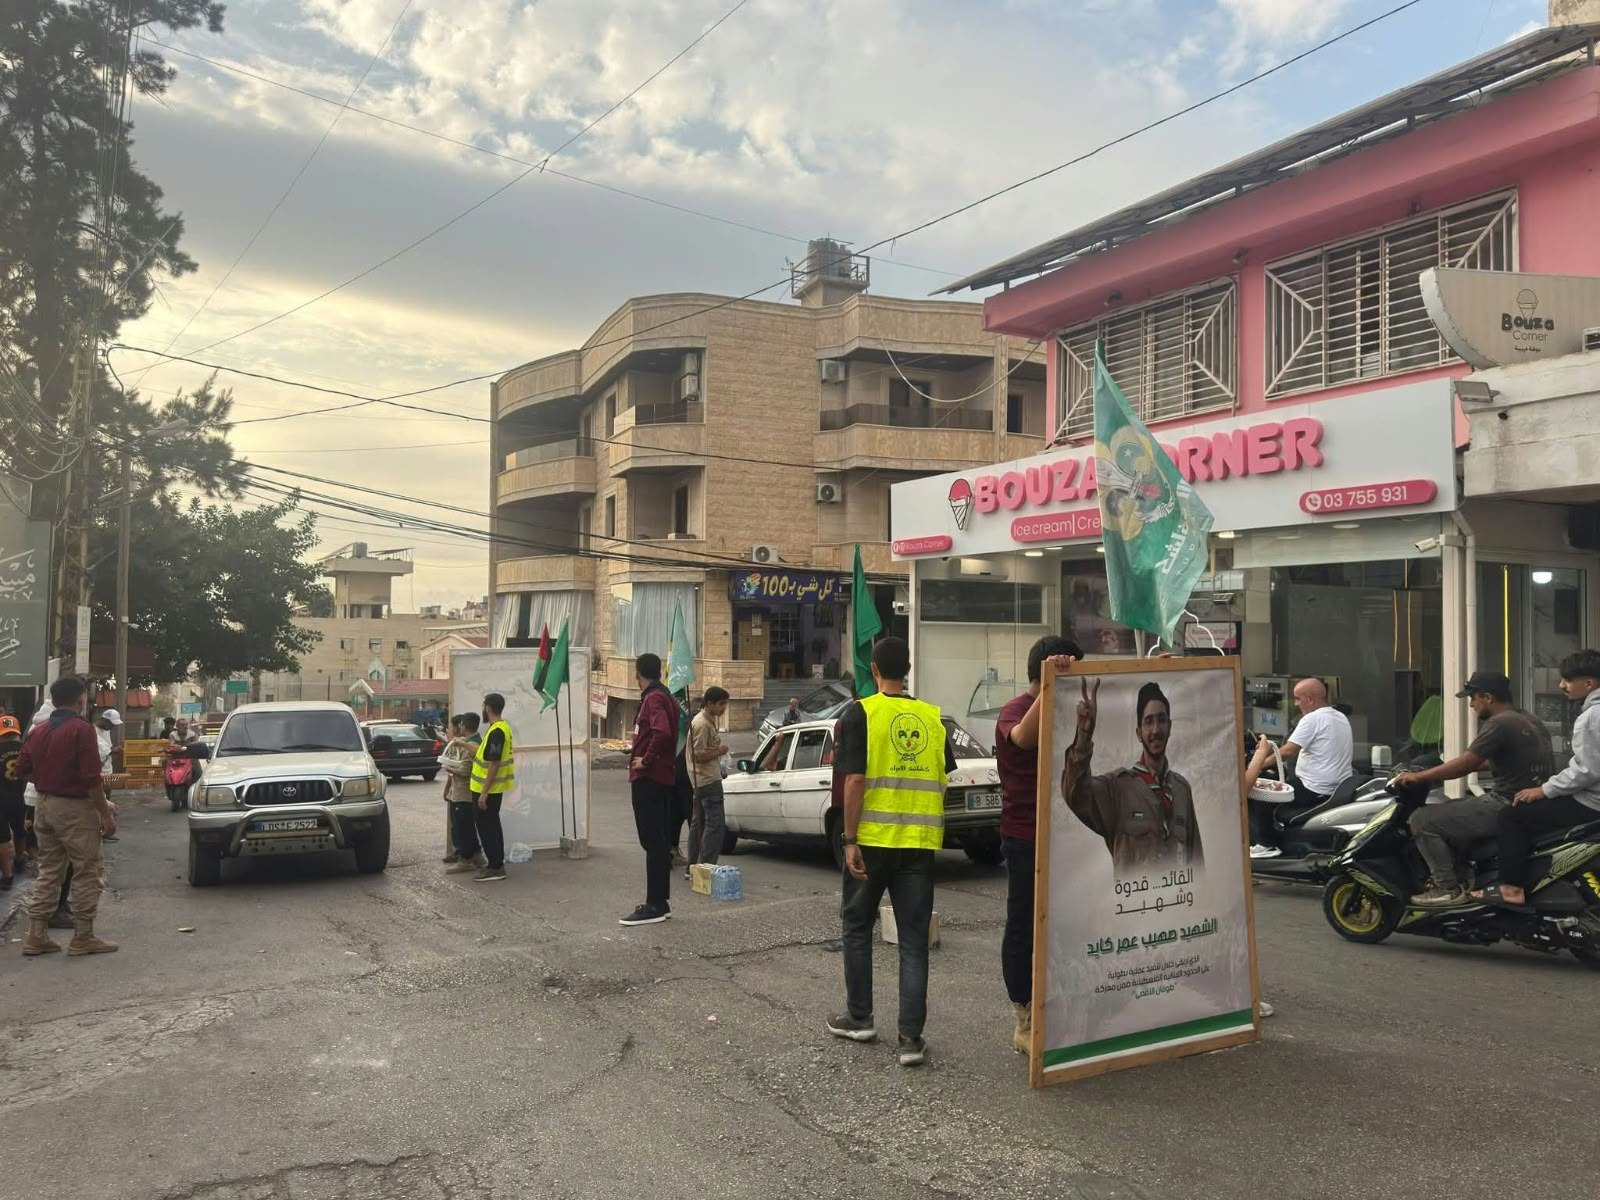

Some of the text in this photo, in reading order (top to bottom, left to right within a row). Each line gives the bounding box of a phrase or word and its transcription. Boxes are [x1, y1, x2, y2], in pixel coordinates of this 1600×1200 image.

[1501, 313, 1555, 331] Bouza
[1512, 330, 1548, 342] Corner
[1323, 486, 1408, 508] 03 755 931
[796, 575, 819, 601] شي
[818, 577, 835, 601] كل
[1114, 875, 1149, 898] قدوة
[1087, 917, 1218, 959] الشهيد صهيب عمر كايد
[1094, 984, 1117, 995] معركة
